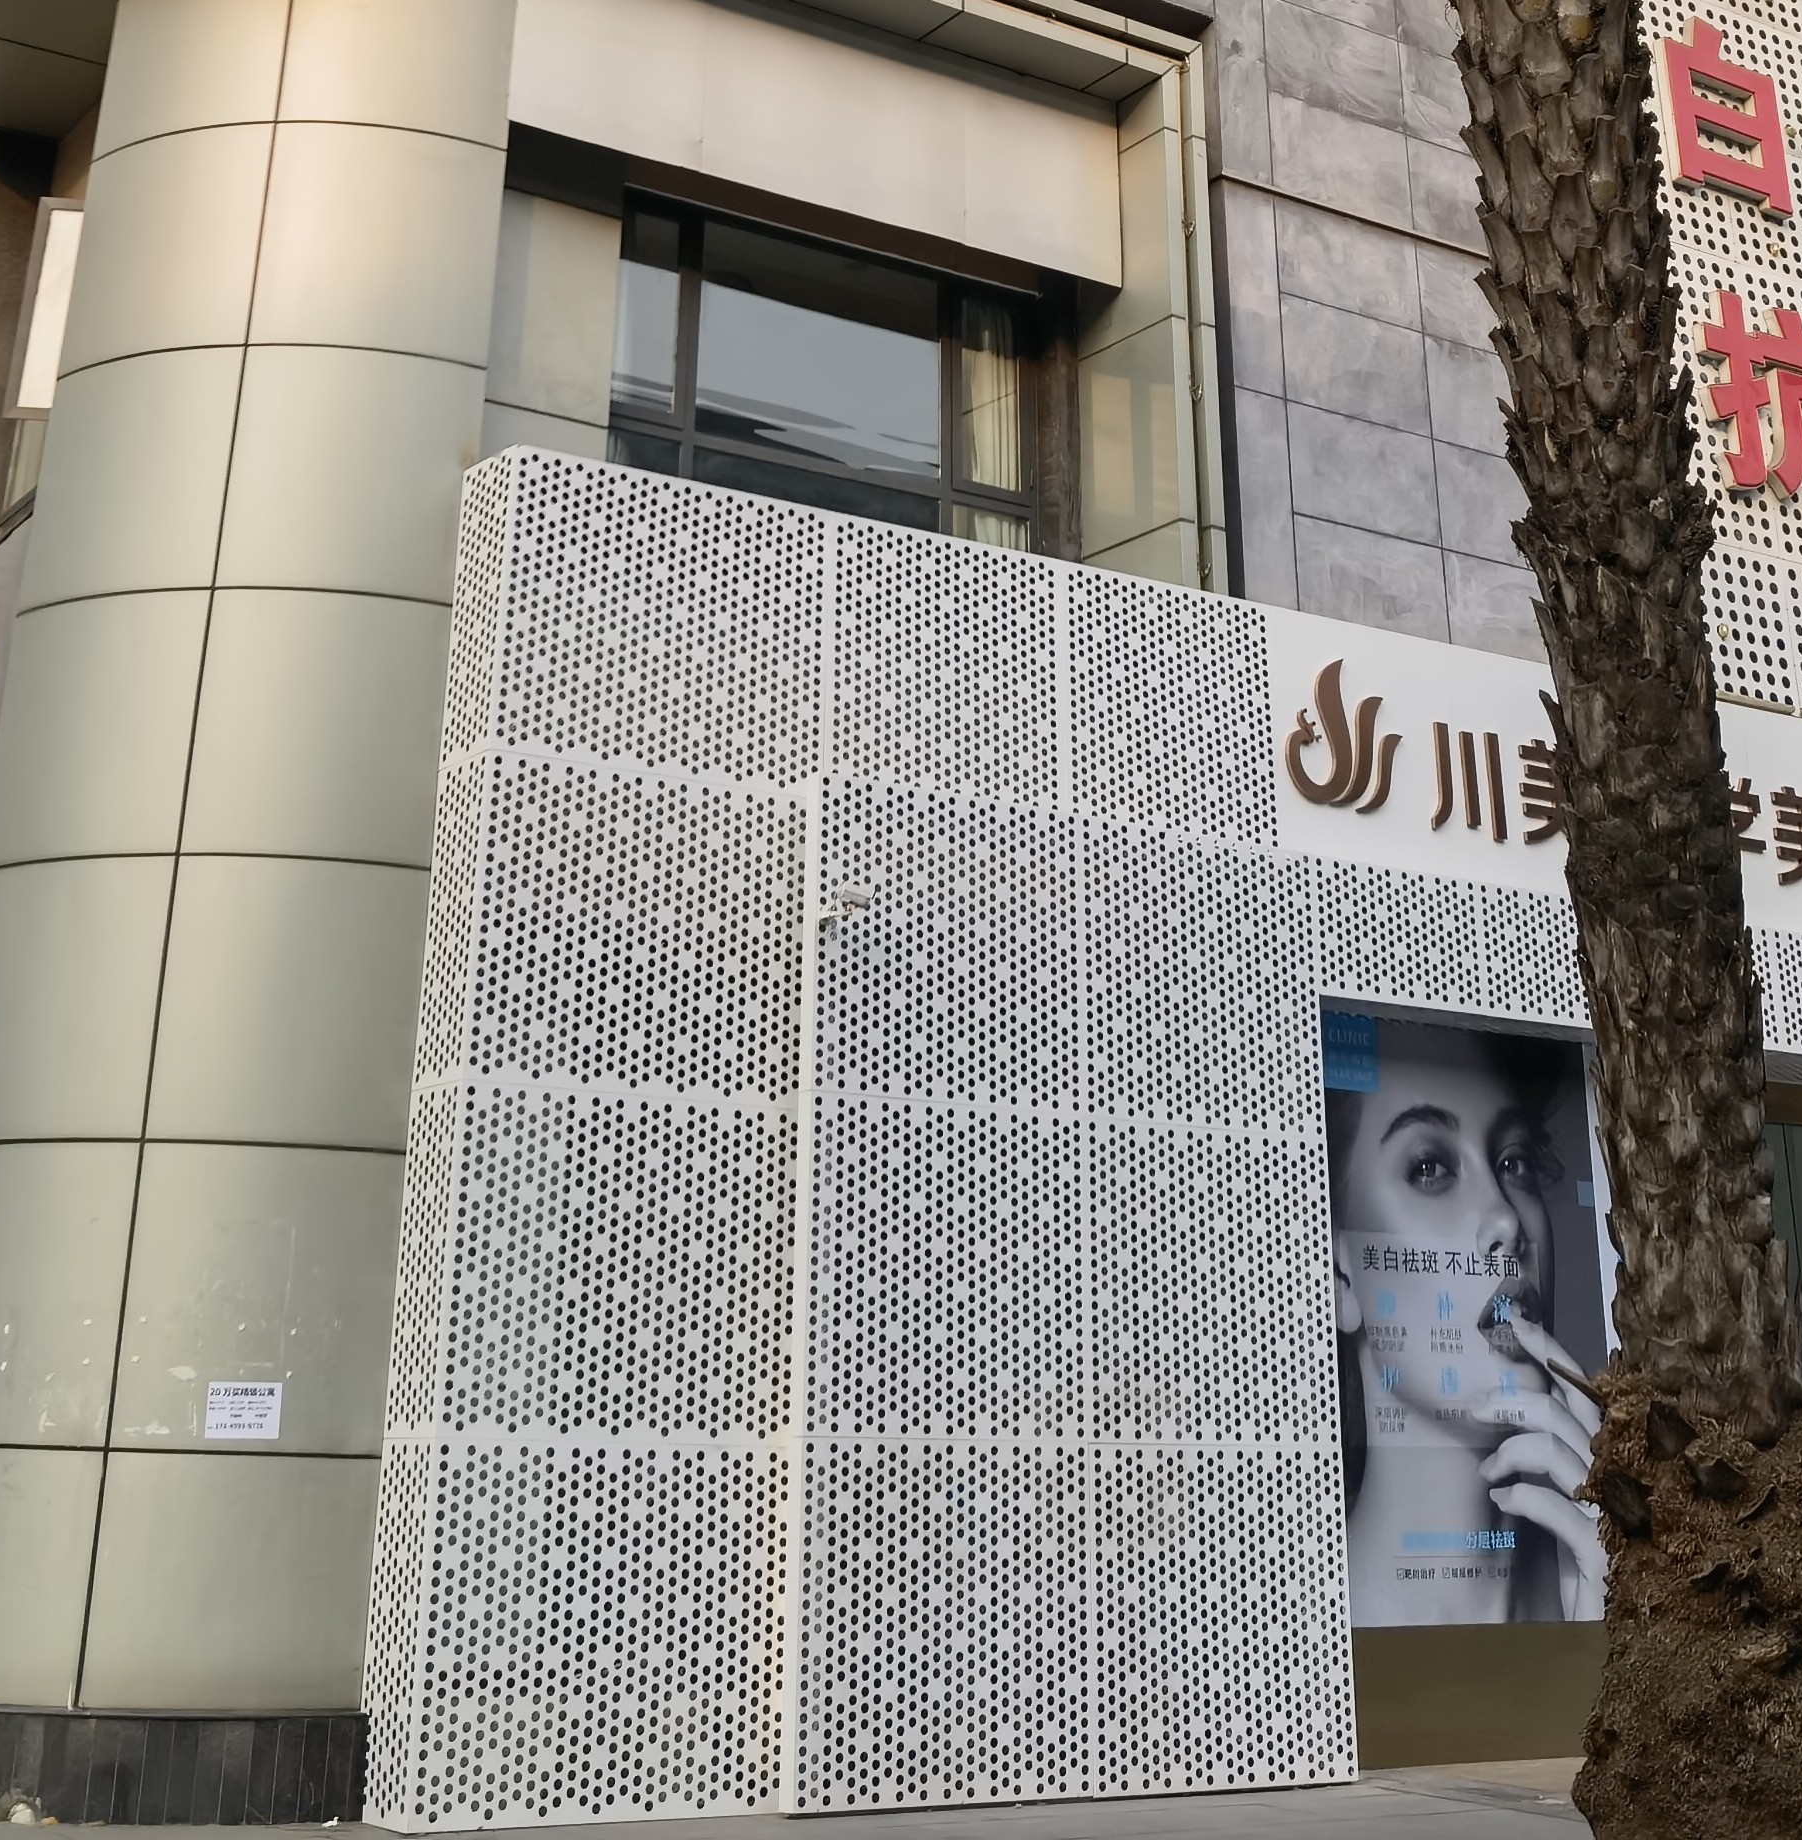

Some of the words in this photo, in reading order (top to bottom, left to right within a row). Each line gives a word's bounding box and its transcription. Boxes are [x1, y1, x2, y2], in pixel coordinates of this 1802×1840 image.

[1363, 1244, 1440, 1274] 美白祛斑
[1445, 1251, 1520, 1279] 不止表面
